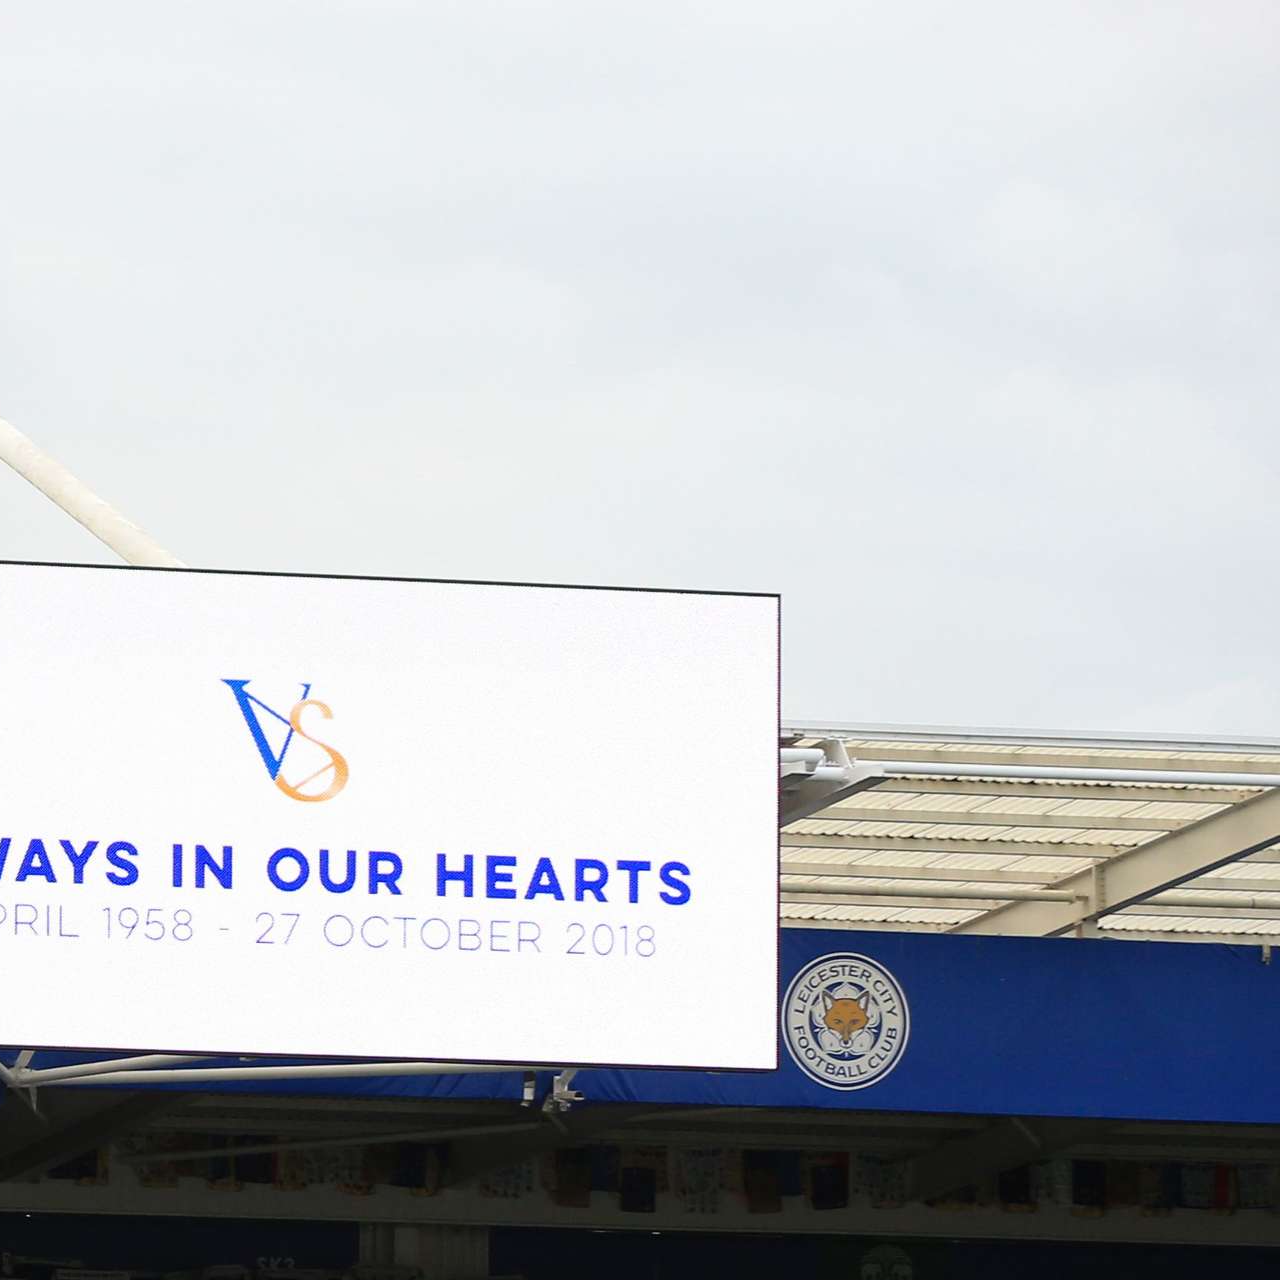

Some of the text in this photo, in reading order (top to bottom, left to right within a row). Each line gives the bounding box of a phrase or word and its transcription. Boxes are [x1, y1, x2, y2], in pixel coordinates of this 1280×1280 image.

[172, 843, 234, 890] IN
[266, 847, 404, 895] OUR
[436, 853, 694, 905] HEARTS
[102, 906, 195, 942] 1958
[255, 913, 303, 946] 27
[323, 915, 543, 954] OCTOBER
[566, 922, 658, 959] 2018
[793, 964, 899, 1018] LEICESTER CITY
[793, 1026, 898, 1078] FOOTBALL CLUB
